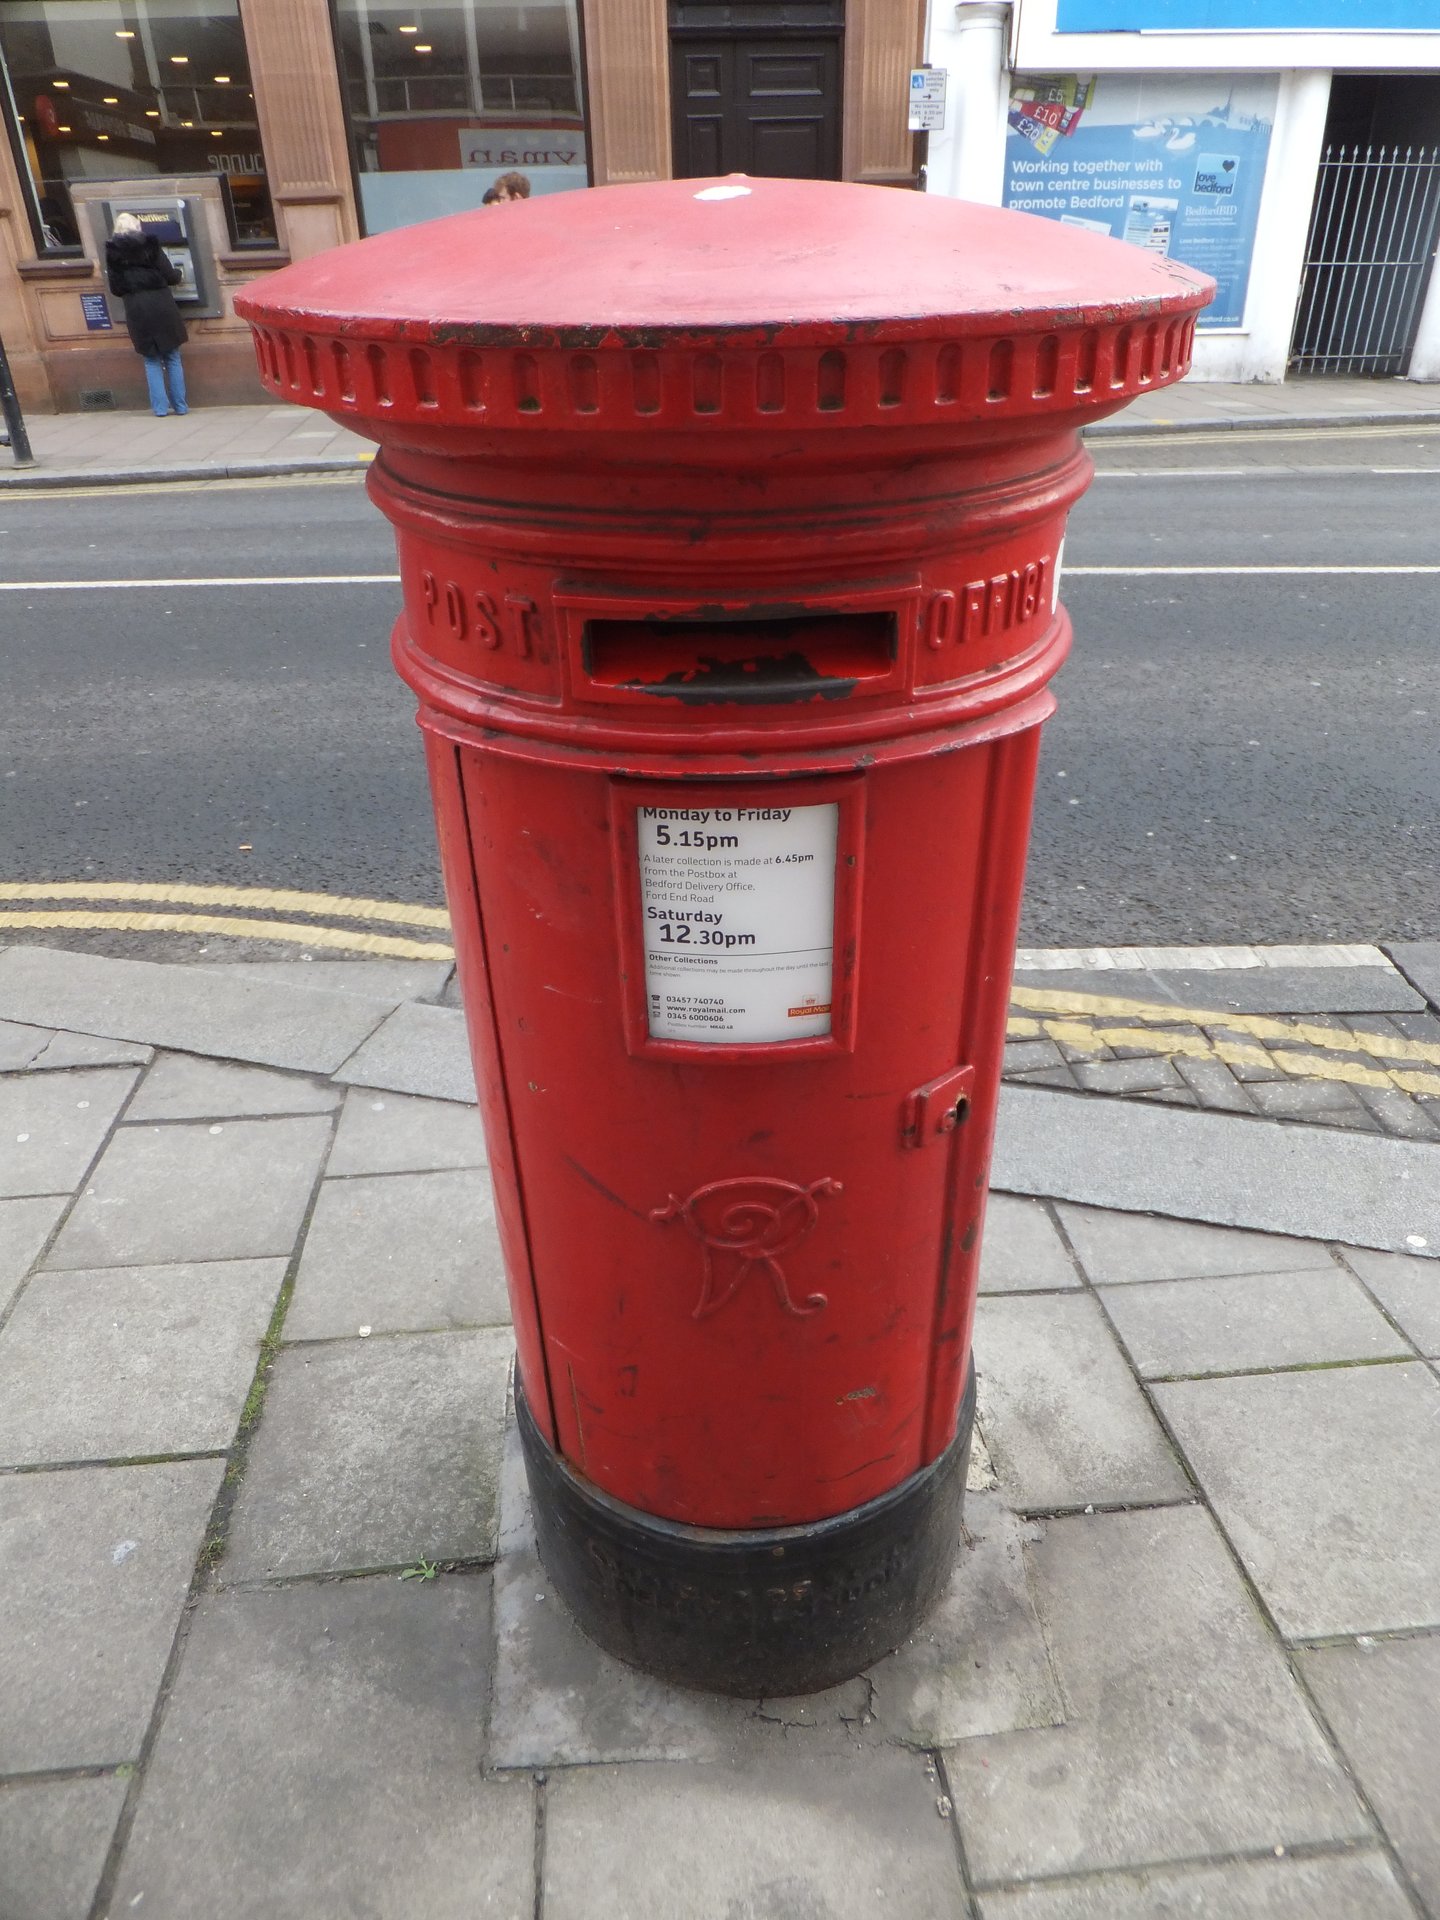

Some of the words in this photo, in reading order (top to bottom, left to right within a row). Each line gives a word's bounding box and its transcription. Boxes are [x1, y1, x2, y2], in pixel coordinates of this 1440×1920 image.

[1048, 88, 1064, 102] £5
[1033, 106, 1058, 126] £10
[1017, 119, 1040, 140] £20
[1012, 160, 1069, 175] Working
[1073, 159, 1131, 175] together
[1135, 159, 1163, 172] with
[1010, 179, 1044, 191] town
[1047, 179, 1090, 191] centre
[1093, 177, 1164, 190] businesses
[1168, 177, 1182, 189] to
[1195, 171, 1216, 184] love
[1194, 182, 1233, 195] bedford
[1009, 196, 1066, 210] promote
[1070, 195, 1124, 208] Bedford
[137, 213, 170, 223] NatWest
[421, 569, 532, 660] POST
[643, 807, 710, 824] Monday
[715, 808, 732, 822] to
[737, 808, 791, 823] Friday
[656, 824, 739, 851] 5.15pm
[644, 854, 651, 862] A
[653, 854, 674, 864] later
[676, 854, 722, 866] collection
[724, 857, 732, 866] is
[734, 857, 761, 866] made
[763, 857, 773, 865] at
[775, 853, 814, 864] 6.45pm
[644, 867, 667, 877] from
[669, 868, 685, 878] the
[687, 869, 725, 879] Postbox
[728, 870, 737, 879] at
[645, 879, 682, 890] Bedford
[685, 881, 724, 892] Delivery
[646, 891, 667, 901] Ford
[669, 892, 687, 902] End
[690, 894, 714, 903] Road
[647, 907, 723, 925] Saturday
[659, 923, 756, 948] 12.30pm
[649, 954, 671, 963] Other
[674, 956, 718, 965] Collections
[666, 995, 691, 1005] 03457
[694, 996, 724, 1005] 740740
[667, 1005, 746, 1015] www.royalmail.com
[790, 1007, 812, 1016] Royal
[813, 1005, 830, 1014] Ma
[667, 1012, 687, 1021] 0345
[689, 1013, 724, 1022] 6000606
